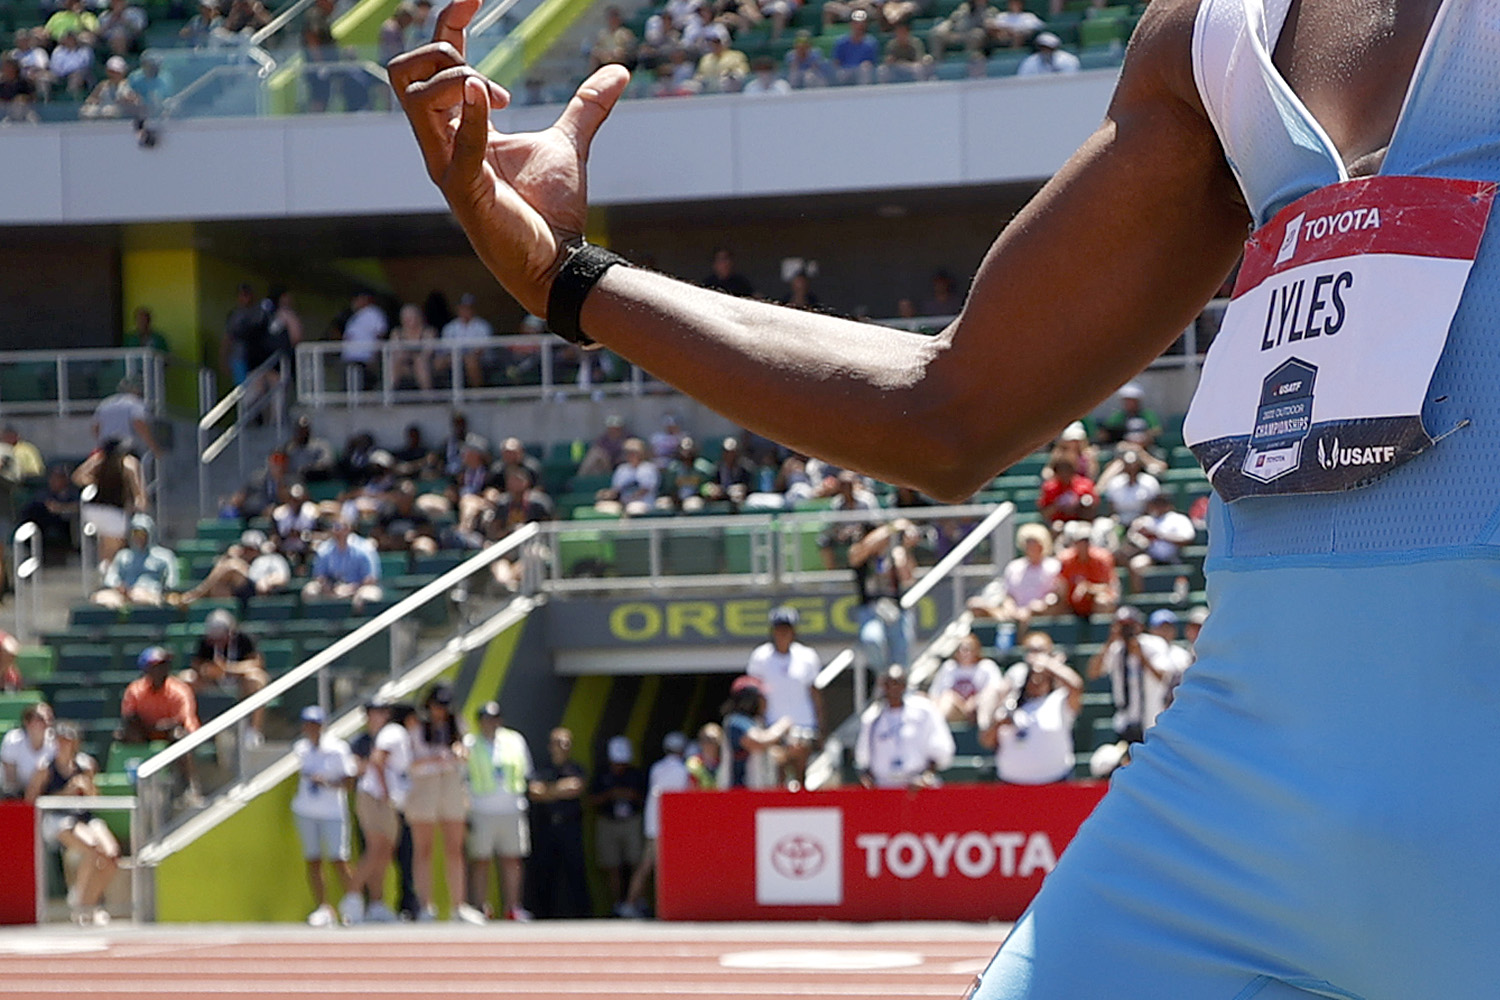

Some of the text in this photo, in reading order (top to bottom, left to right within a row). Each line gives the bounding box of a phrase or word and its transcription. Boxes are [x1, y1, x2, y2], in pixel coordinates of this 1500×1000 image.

[1305, 207, 1381, 242] TOYOTA
[1261, 271, 1353, 351] LYLES
[1279, 381, 1303, 395] USATF
[1275, 403, 1305, 418] OUTDOOR
[1254, 416, 1309, 438] CHAMPIONSHIPS
[1339, 446, 1395, 466] USATF
[856, 831, 1058, 878] TOYOTA
